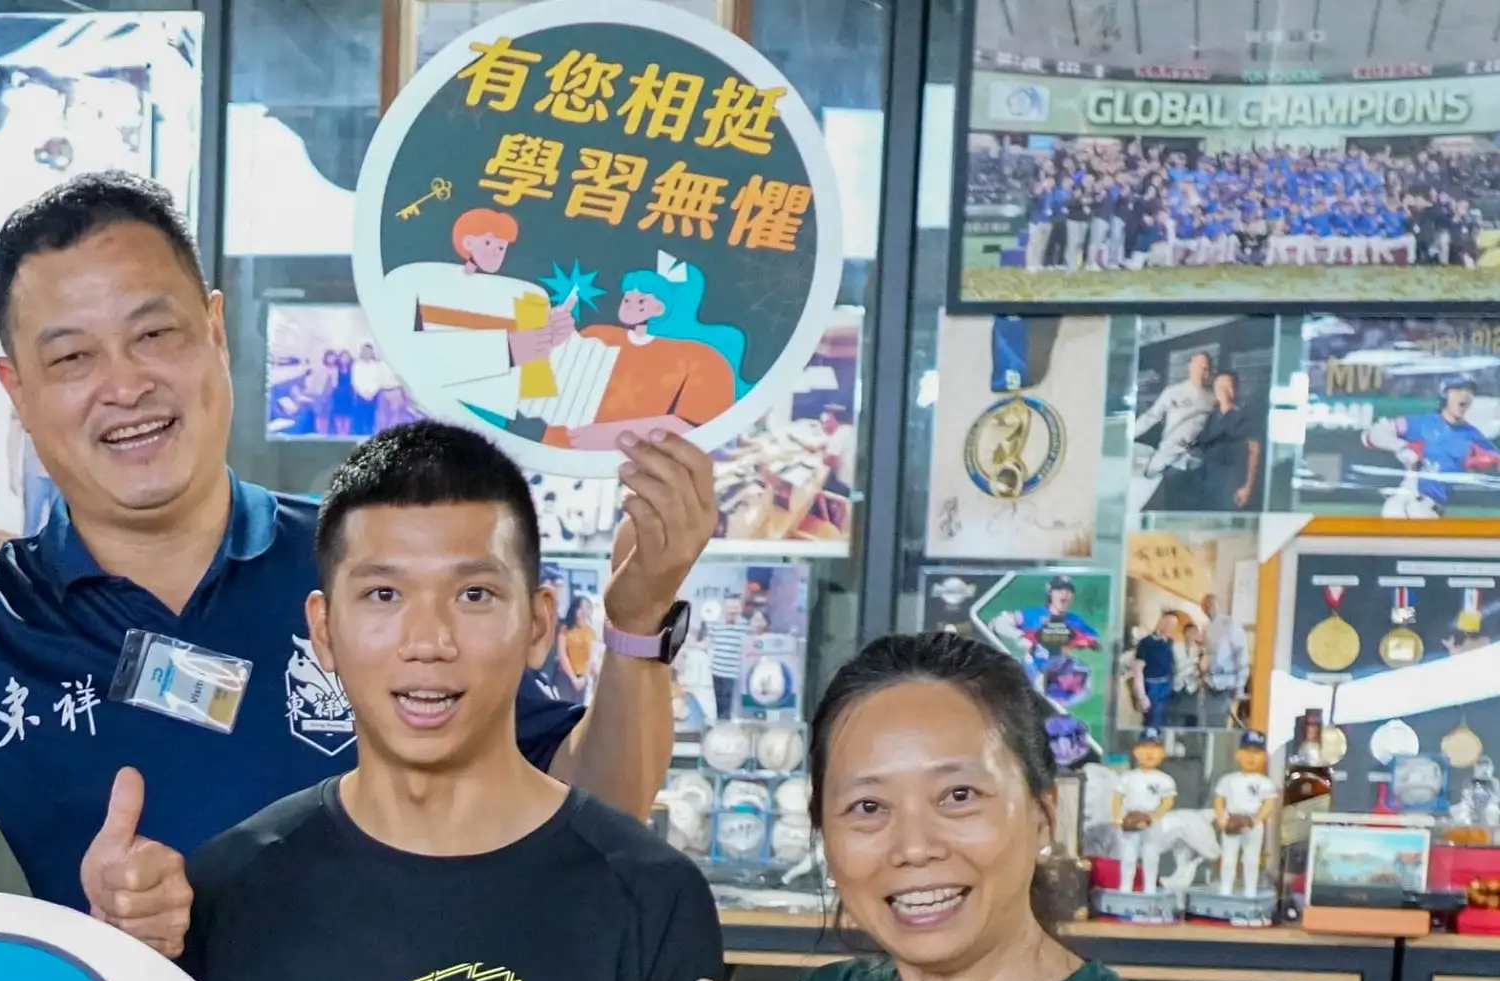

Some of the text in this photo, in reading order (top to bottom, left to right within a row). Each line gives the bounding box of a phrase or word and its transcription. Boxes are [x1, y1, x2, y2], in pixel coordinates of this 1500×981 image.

[456, 36, 788, 155] 有您相挺
[1085, 87, 1472, 129] GLOBAL CHAMPIONS
[478, 132, 813, 252] 學習無懼
[190, 669, 206, 705] Visit
